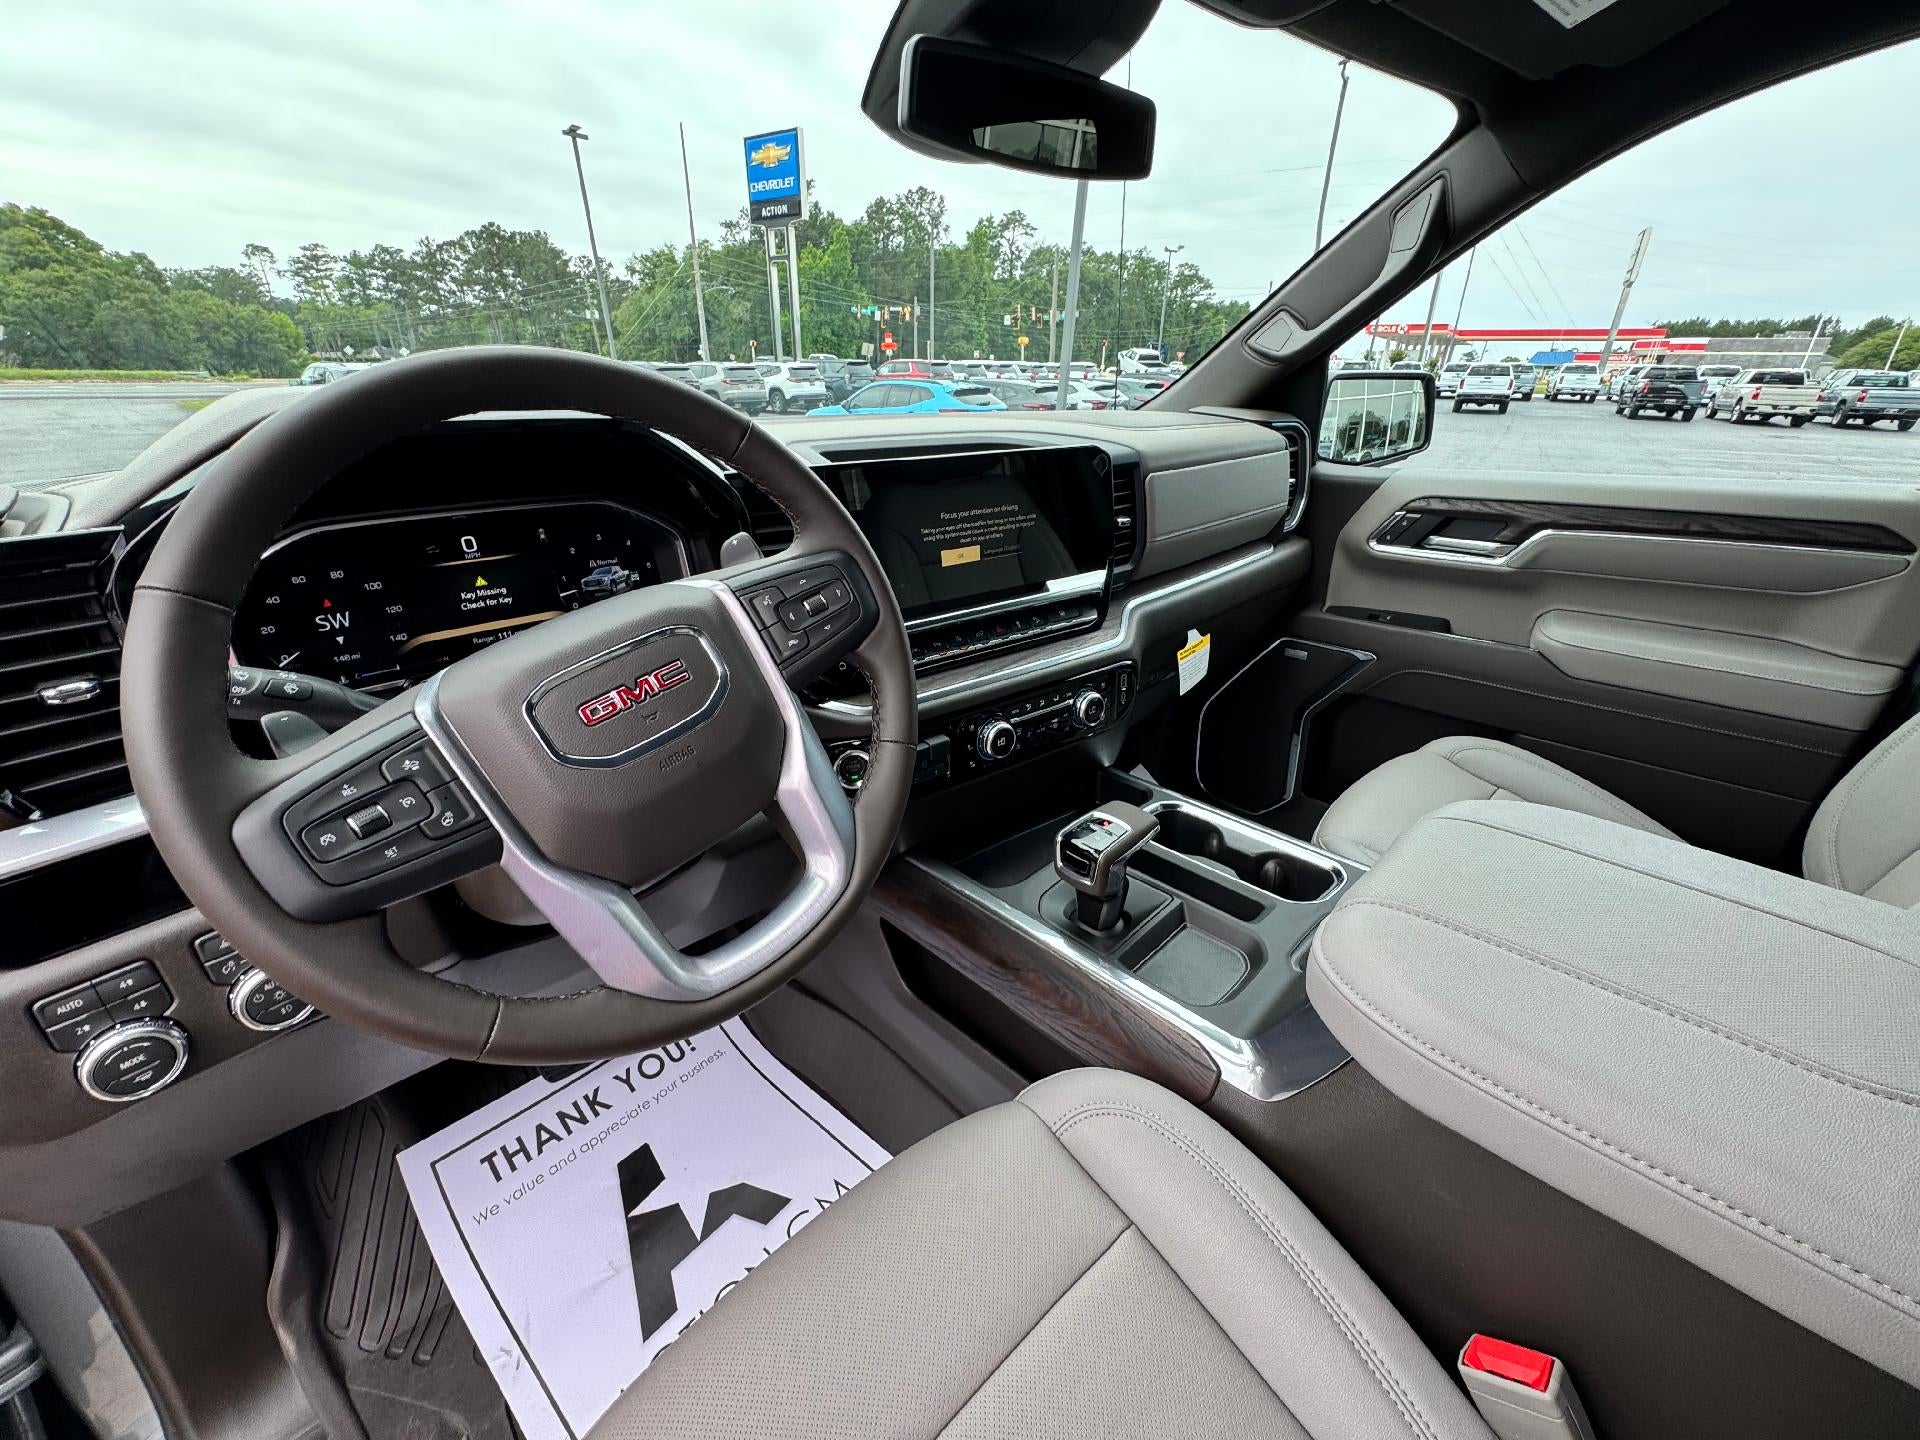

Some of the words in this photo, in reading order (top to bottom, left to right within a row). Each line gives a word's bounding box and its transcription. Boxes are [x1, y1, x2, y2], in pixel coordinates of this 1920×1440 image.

[750, 177, 795, 193] CHEVROLET
[761, 204, 788, 217] ACTION
[940, 511, 957, 520] Focus
[958, 511, 970, 520] your
[970, 507, 993, 516] attention
[1001, 504, 1019, 512] driving
[596, 533, 602, 541] 3
[460, 535, 478, 553] 0
[464, 552, 481, 560] MPH
[596, 557, 618, 566] Normal
[291, 575, 306, 584] 60
[330, 570, 344, 579] 80
[364, 581, 382, 591] 100
[460, 591, 476, 600] Key
[476, 587, 507, 598] Missing
[266, 595, 281, 605] 40
[461, 600, 486, 611] Check
[486, 598, 498, 606] for
[498, 597, 513, 605] Key
[385, 605, 403, 614] 120
[315, 610, 350, 632] SW
[260, 625, 276, 635] 20
[389, 633, 408, 642] 140
[472, 635, 497, 645] Range:
[497, 630, 513, 640] 111
[333, 654, 351, 663] 148
[351, 652, 361, 661] mi
[231, 685, 247, 694] OFF
[578, 658, 692, 727] GMC
[659, 744, 697, 772] AIRBAG
[341, 786, 358, 797] RES
[384, 846, 399, 858] SET
[56, 999, 84, 1015] AUTO
[119, 1053, 147, 1070] MODE
[472, 1203, 500, 1226] We
[503, 1172, 545, 1206] value
[548, 1148, 577, 1176] and
[579, 1099, 651, 1153] appreciate
[651, 1081, 679, 1104] your
[679, 1049, 727, 1083] business.
[479, 1085, 614, 1183] THANK
